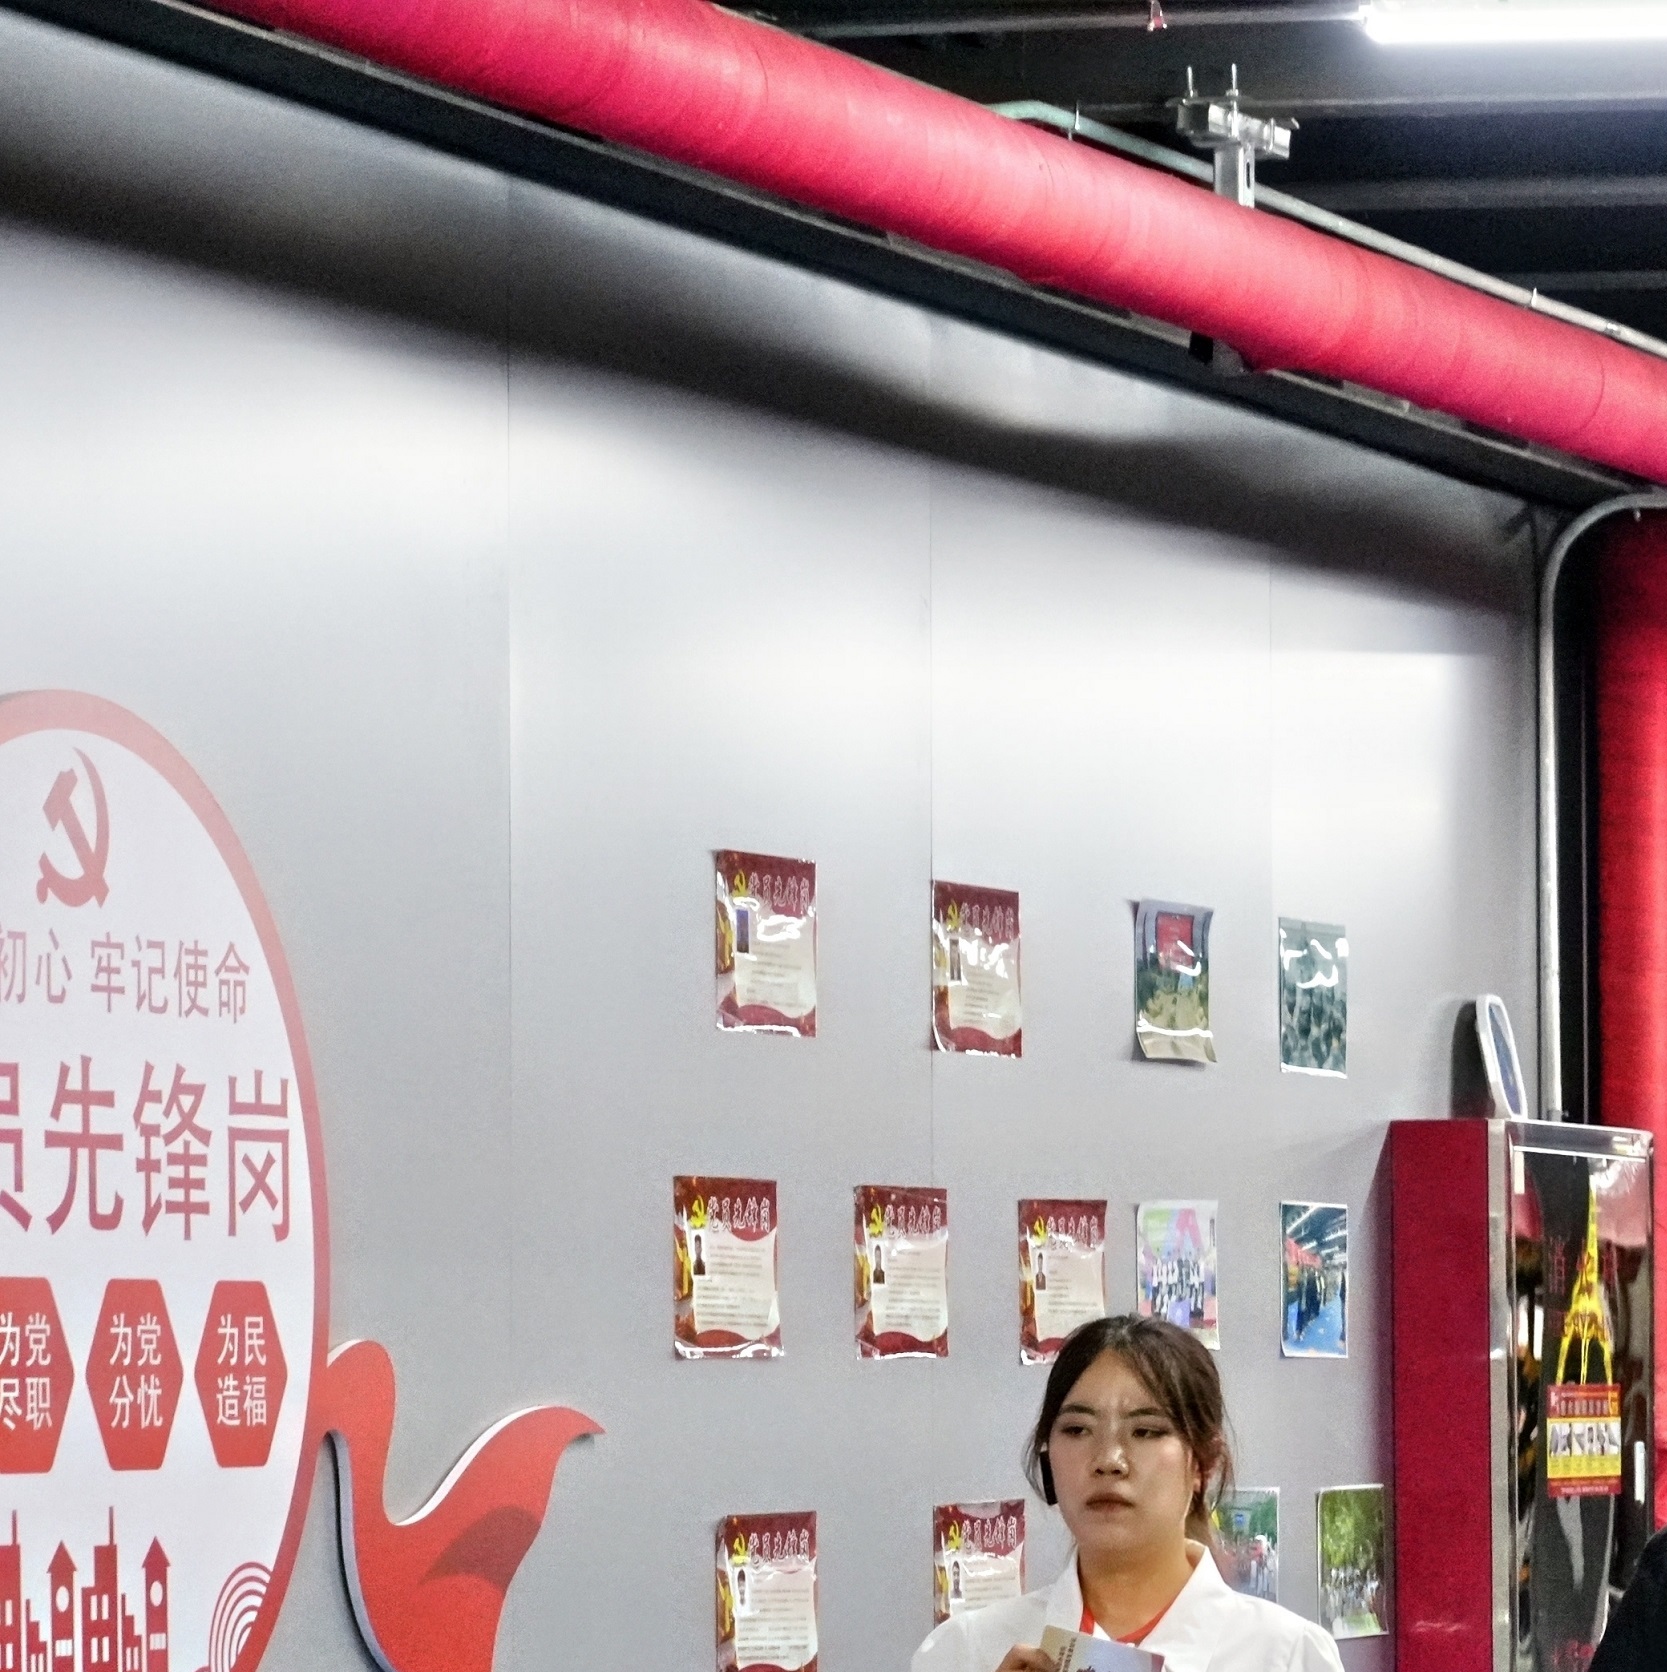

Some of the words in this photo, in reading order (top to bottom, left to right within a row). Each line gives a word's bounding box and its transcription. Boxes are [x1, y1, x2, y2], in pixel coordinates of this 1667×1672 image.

[90, 931, 251, 1025] 牢记使命
[0, 1312, 51, 1367] 为党
[109, 1312, 163, 1367] 为党
[216, 1313, 268, 1367] 为民
[0, 1377, 53, 1431] 尽职
[108, 1374, 164, 1430] 分忧
[216, 1374, 268, 1428] 造福
